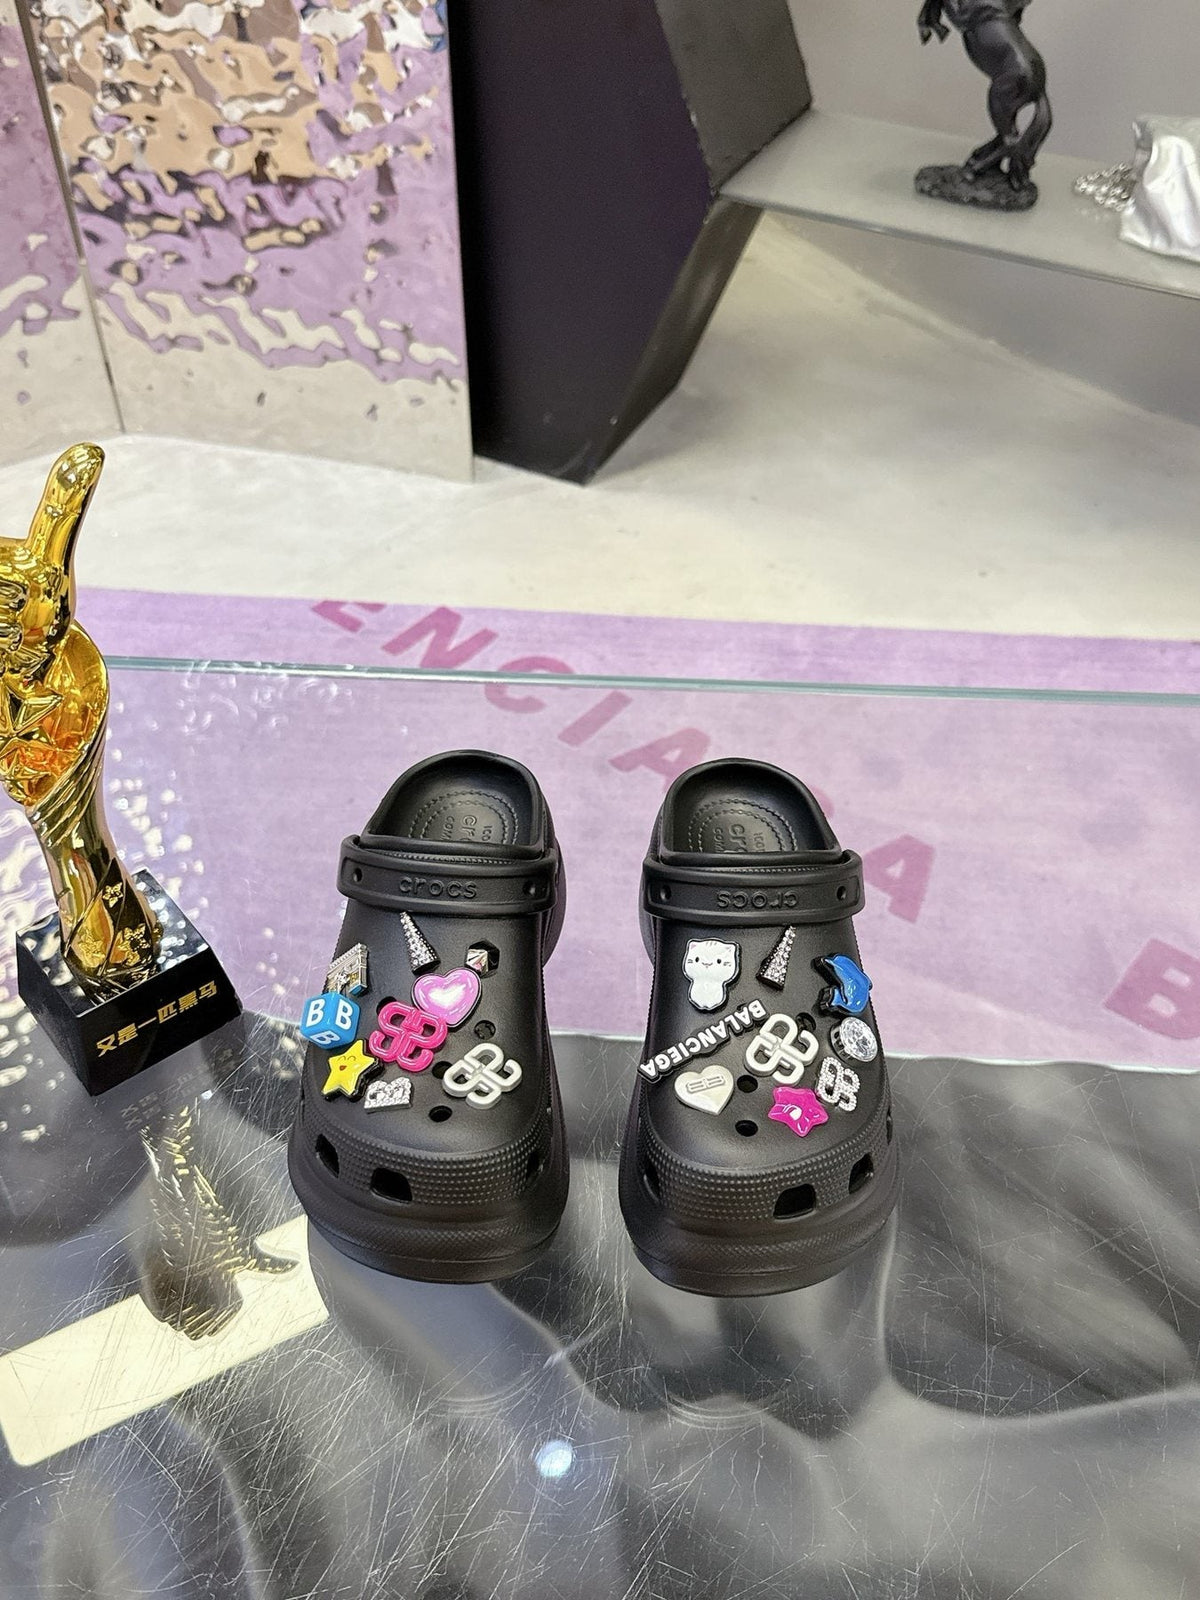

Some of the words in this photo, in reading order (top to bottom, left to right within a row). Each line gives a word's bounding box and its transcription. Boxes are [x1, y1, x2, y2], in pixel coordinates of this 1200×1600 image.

[399, 877, 479, 900] crocs
[716, 888, 800, 910] crocs
[96, 980, 218, 1057] 又是一匹黑马
[639, 999, 767, 1077] BALANCIEGA
